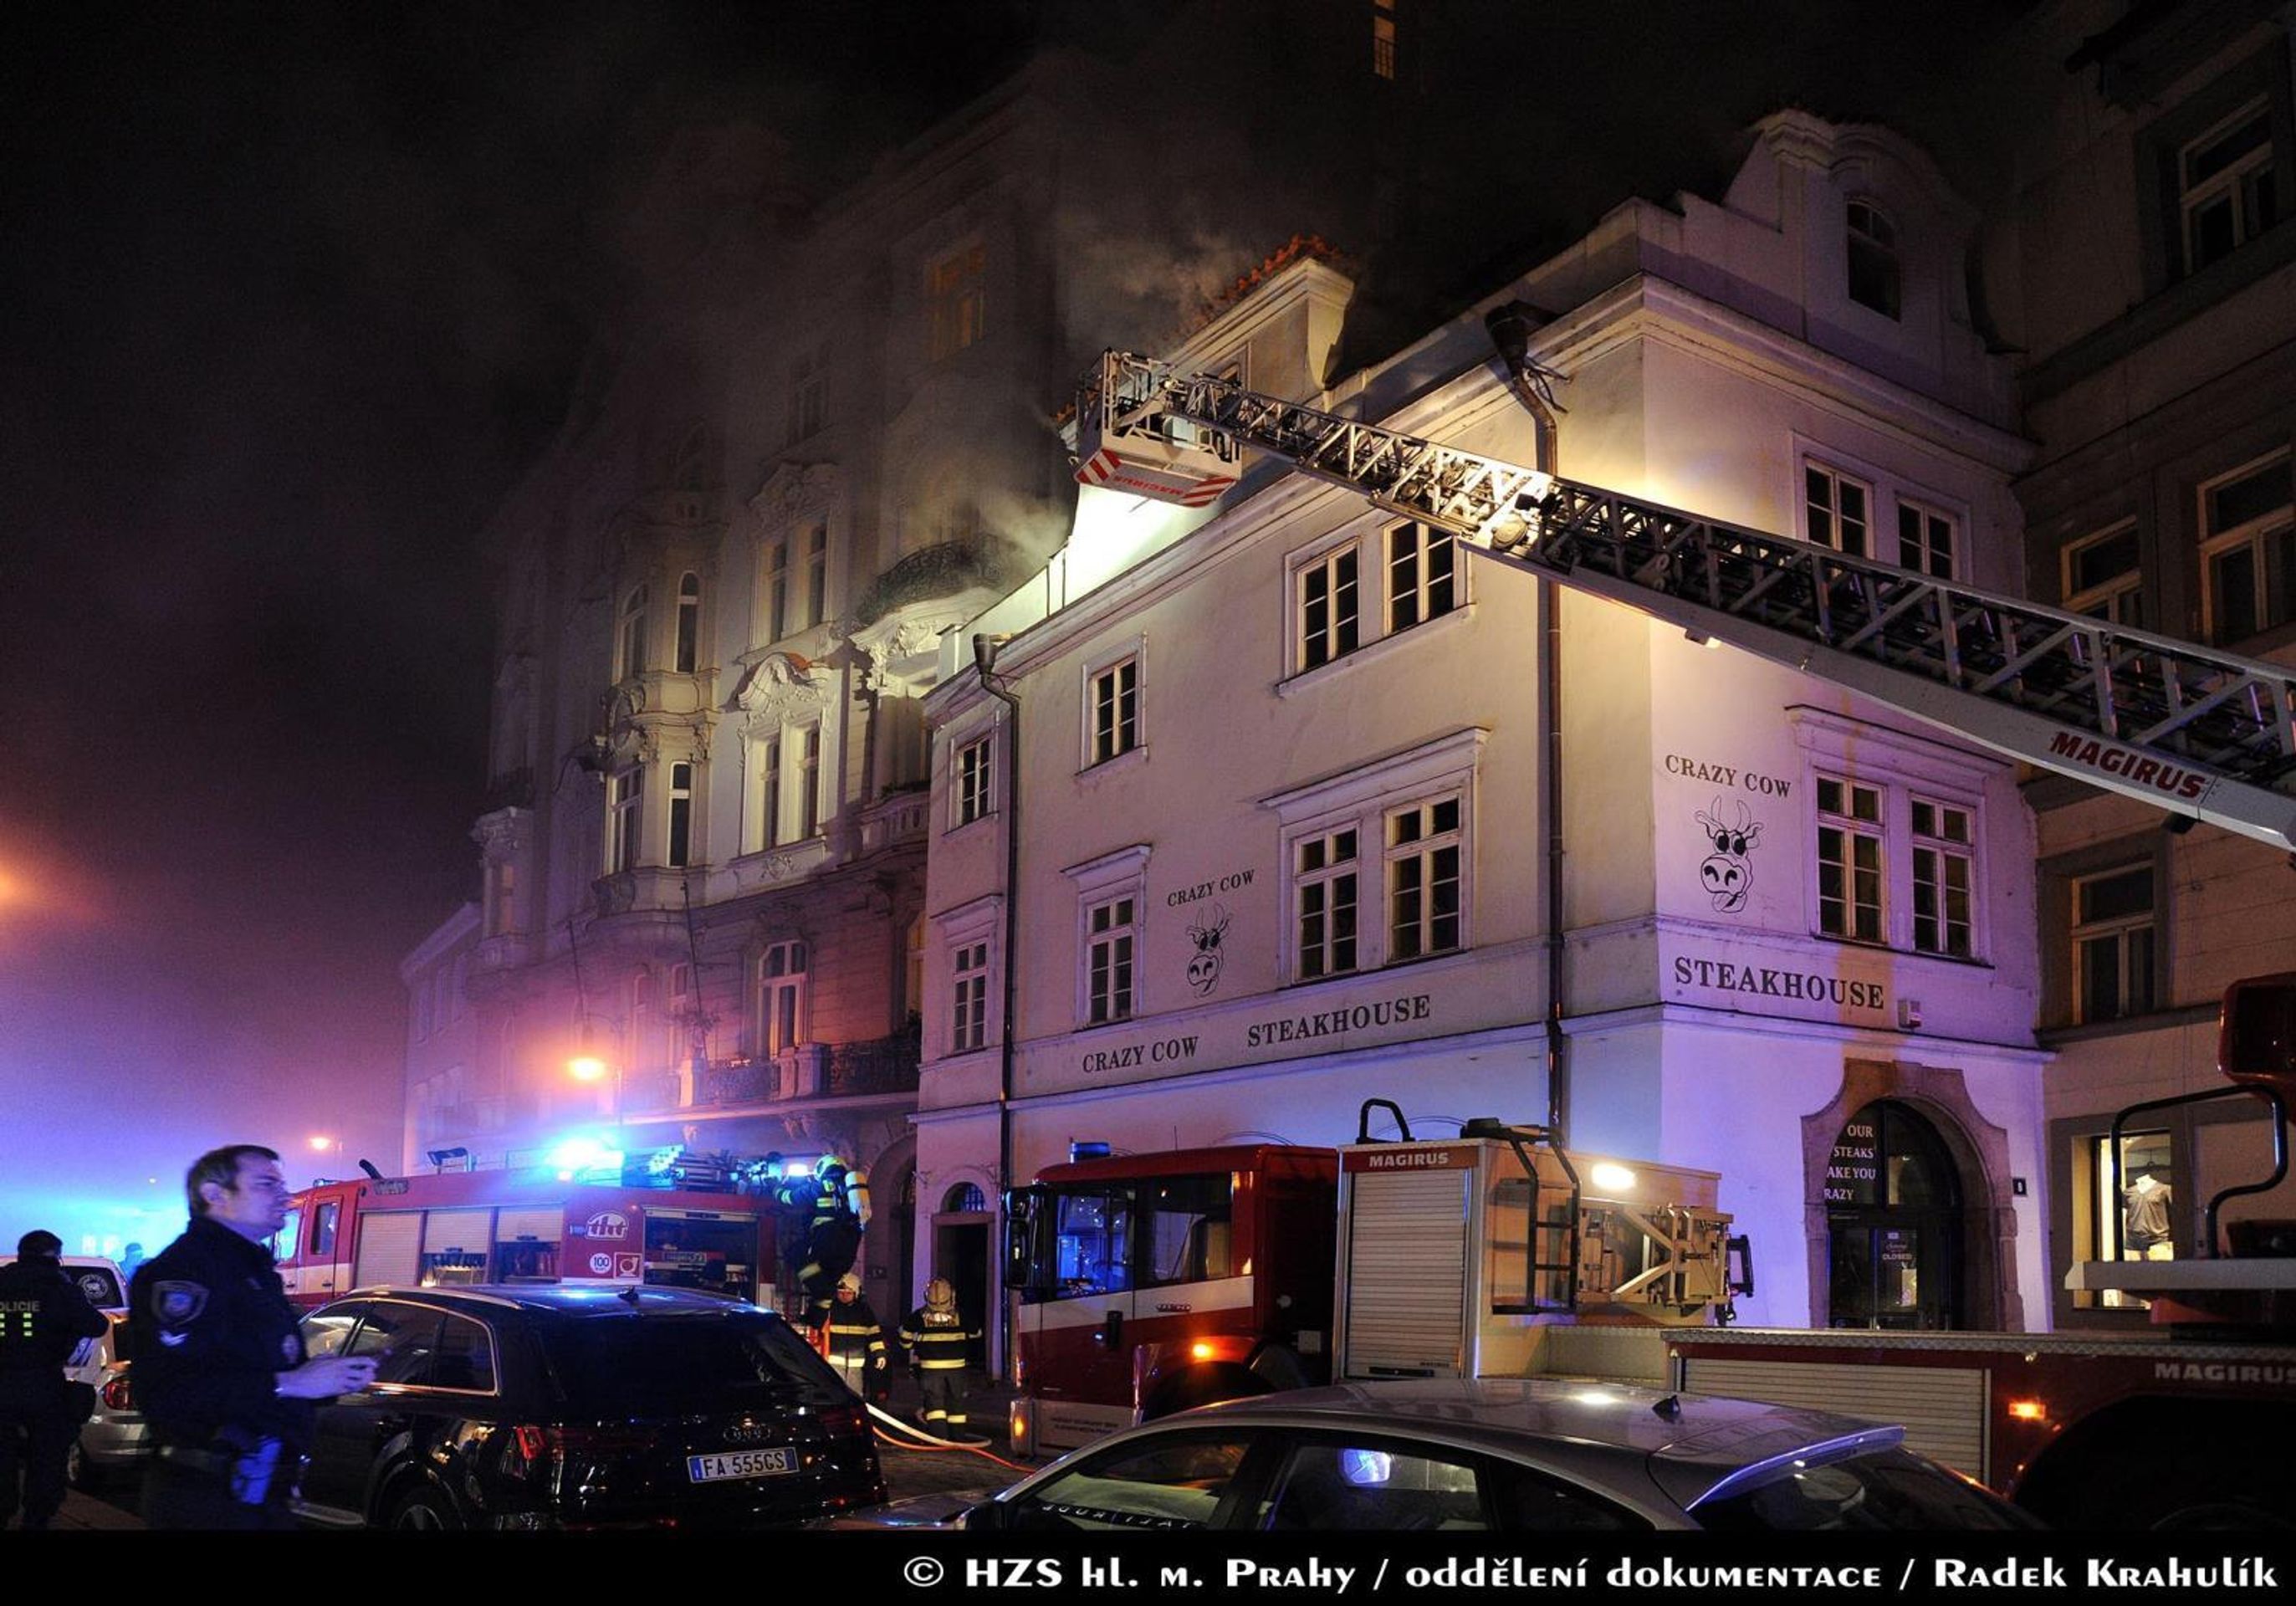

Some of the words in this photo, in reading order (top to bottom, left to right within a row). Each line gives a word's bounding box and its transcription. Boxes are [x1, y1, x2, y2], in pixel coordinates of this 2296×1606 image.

[2049, 731, 2207, 799] MAGIRUS
[1665, 754, 1737, 786] CRAZY
[1744, 773, 1792, 797] COW
[1168, 880, 1215, 908] CRAZY
[1220, 869, 1255, 892] COW
[1675, 956, 1884, 1009] STEAKHOUSE
[1082, 1046, 1145, 1073] CRAZY
[1152, 1036, 1199, 1062] COW
[1247, 995, 1431, 1047] STEAKHOUSE
[1847, 1124, 1874, 1138] OUR
[1369, 1152, 1449, 1168] MAGIRUS
[1833, 1146, 1874, 1159] STEAKS
[1826, 1166, 1851, 1179] AKE
[1853, 1168, 1876, 1180] YOU
[1823, 1188, 1854, 1200] RAZY
[593, 1257, 610, 1266] 100
[0, 1300, 41, 1312] OLICIE
[703, 1458, 726, 1476] FA
[733, 1452, 785, 1474] 555GS
